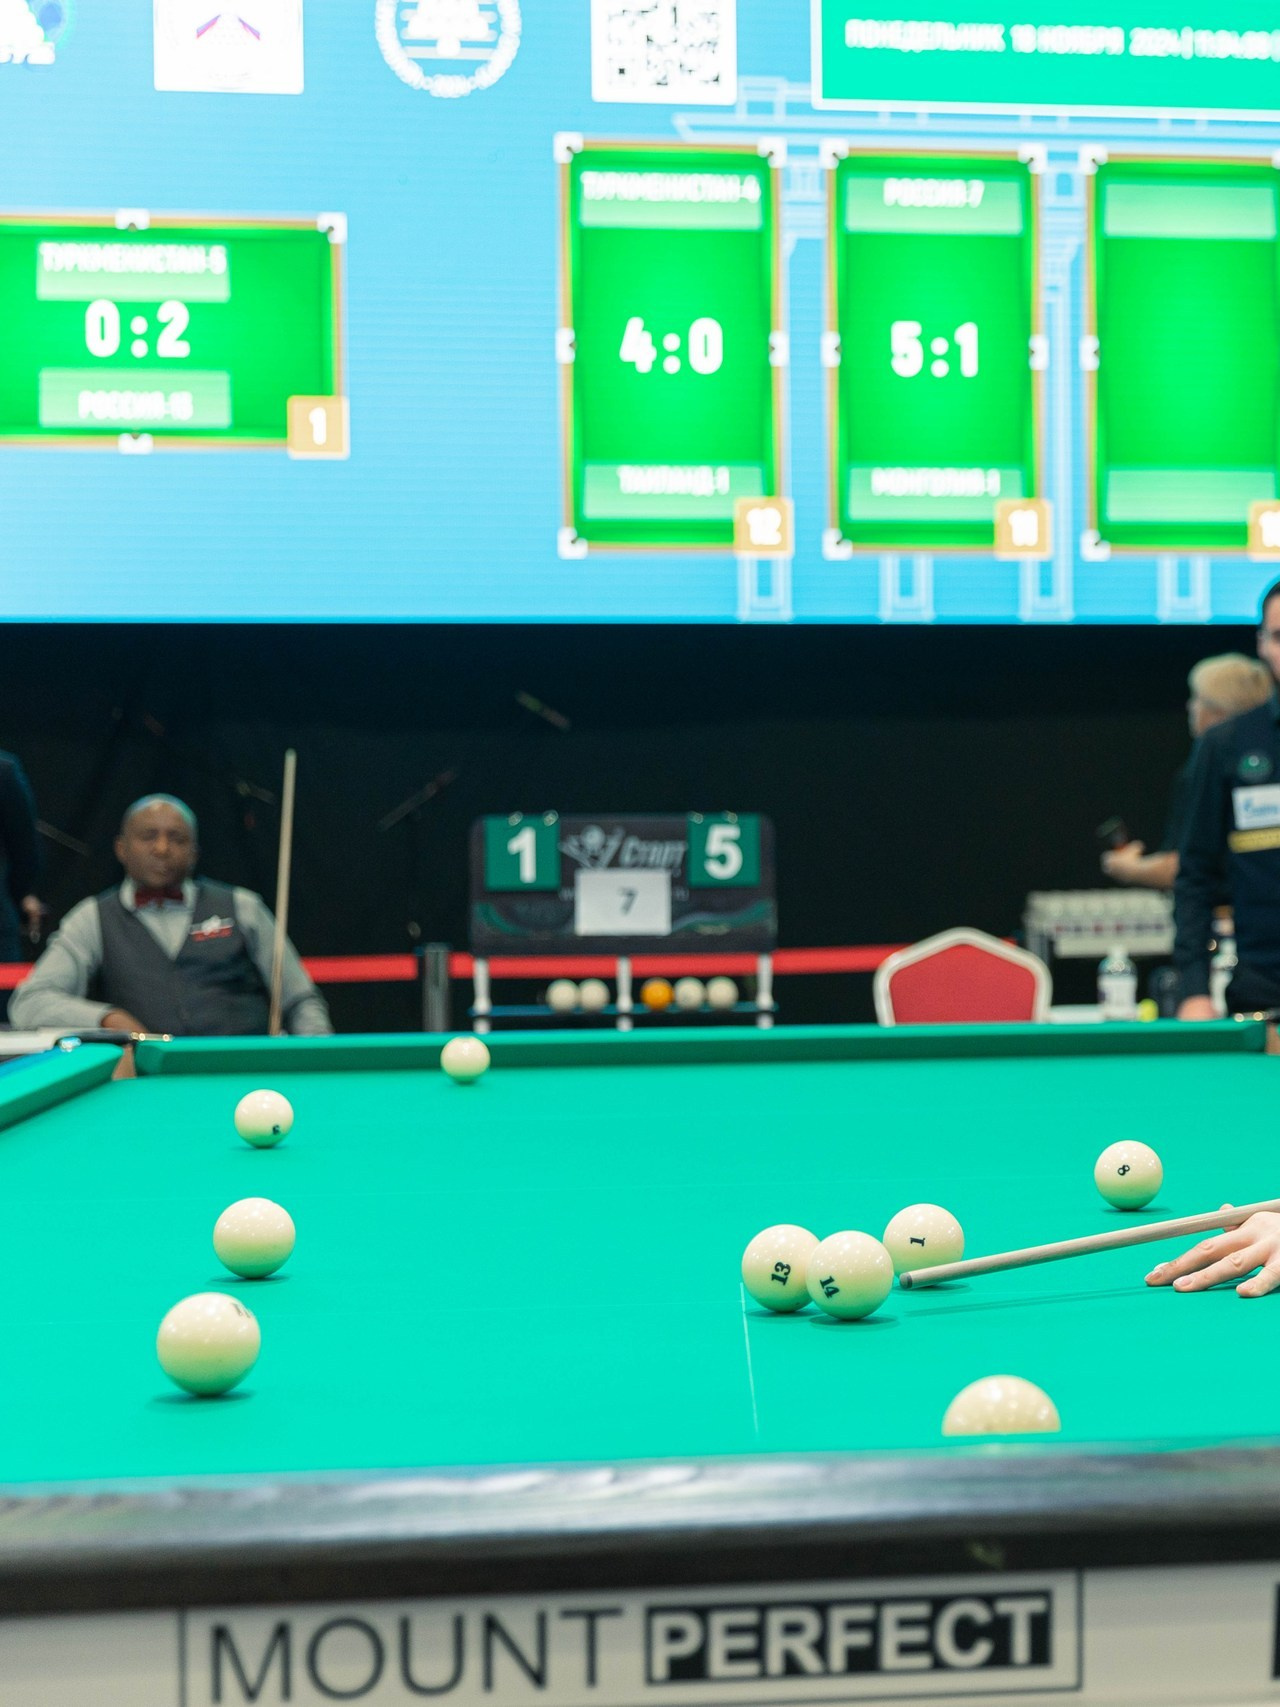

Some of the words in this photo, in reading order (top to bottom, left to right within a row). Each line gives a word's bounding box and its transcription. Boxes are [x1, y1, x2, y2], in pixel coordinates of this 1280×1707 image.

[84, 298, 190, 358] 0:2
[619, 317, 723, 375] 4:0
[890, 321, 979, 378] 5:1
[308, 406, 328, 446] 1
[507, 826, 537, 884] 1
[704, 823, 744, 880] 5
[617, 887, 639, 917] 7
[1117, 1164, 1131, 1176] 8
[909, 1236, 926, 1247] 1
[771, 1261, 792, 1286] 13
[819, 1275, 840, 1299] 14
[210, 1607, 625, 1704] MOUNT
[649, 1598, 1048, 1682] PERFECT
